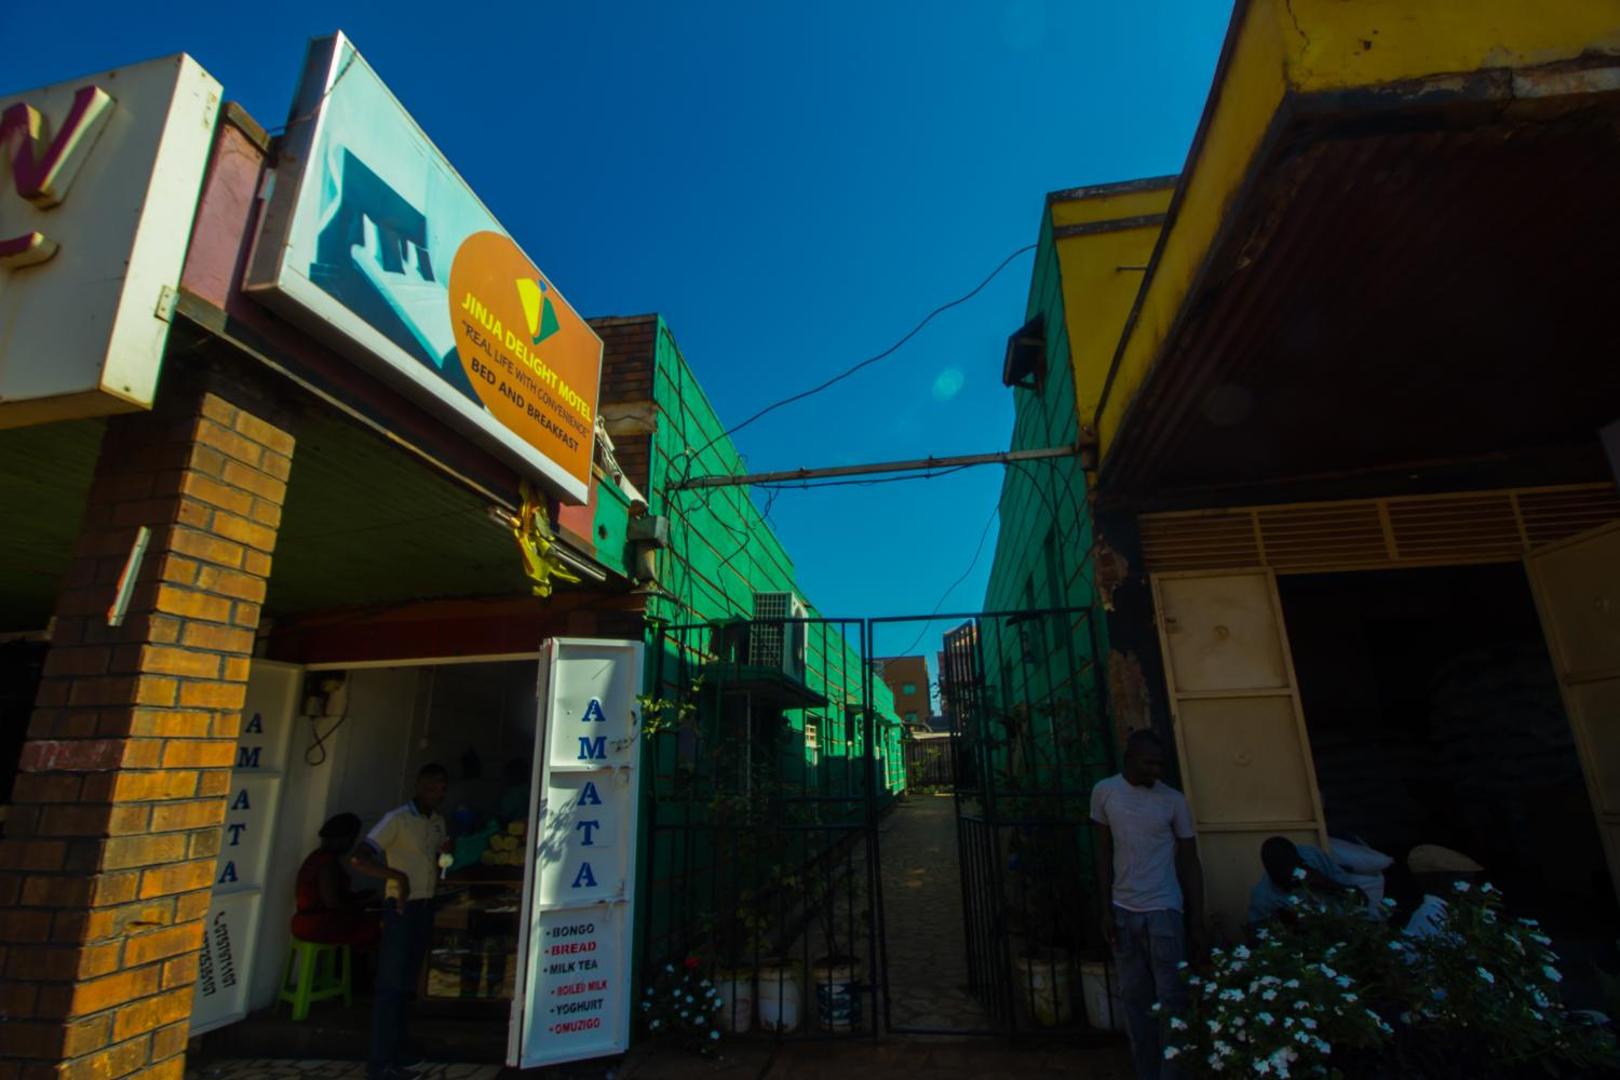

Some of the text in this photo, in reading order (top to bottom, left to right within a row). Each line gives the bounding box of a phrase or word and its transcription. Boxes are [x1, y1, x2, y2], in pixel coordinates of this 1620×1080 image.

[461, 292, 592, 422] JINJA DELIGHT MOTEL
[494, 350, 513, 375] LIFE
[515, 367, 537, 394] WITH
[471, 358, 579, 453] BED AND BREAKFAST
[219, 713, 263, 883] AMATA
[572, 699, 607, 888] AMATA
[552, 923, 594, 938] BONGO
[551, 941, 597, 956] BREAD
[549, 959, 598, 975] MILK TEA
[556, 980, 607, 996] BOILED MILK
[556, 998, 603, 1015] YOGHURT
